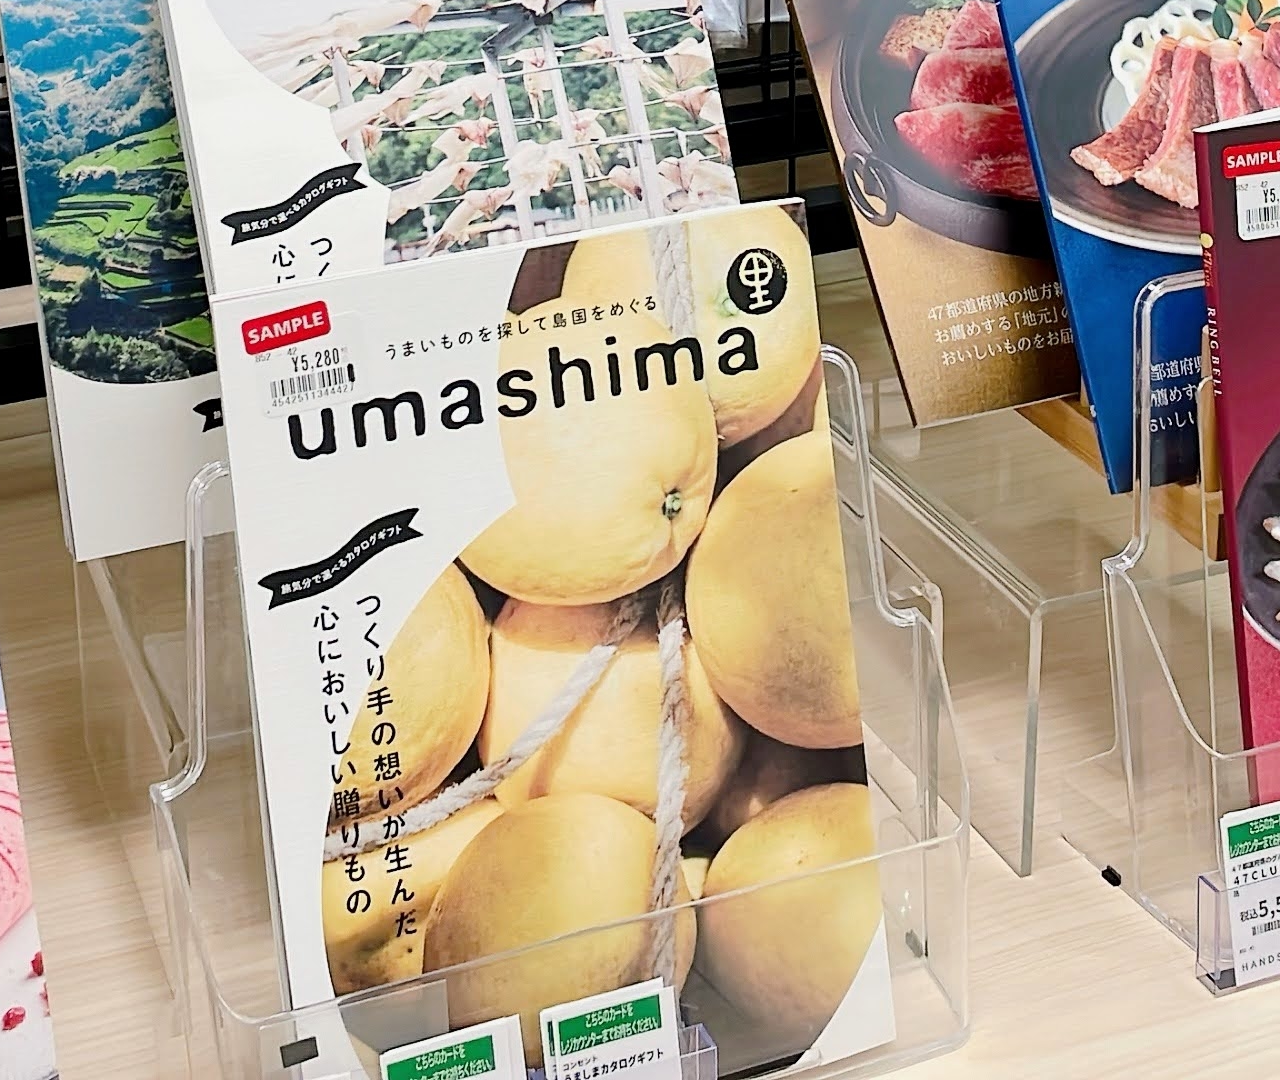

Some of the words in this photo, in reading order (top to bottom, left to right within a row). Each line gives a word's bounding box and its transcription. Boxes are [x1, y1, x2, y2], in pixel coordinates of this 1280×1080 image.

[247, 309, 326, 345] SAMPLE
[288, 325, 759, 461] umashima
[384, 294, 658, 361] うまいものを探して島国をめぐる
[313, 604, 373, 914] 心においしい贈りもの
[356, 593, 418, 938] つくり手の想いが生んだ
